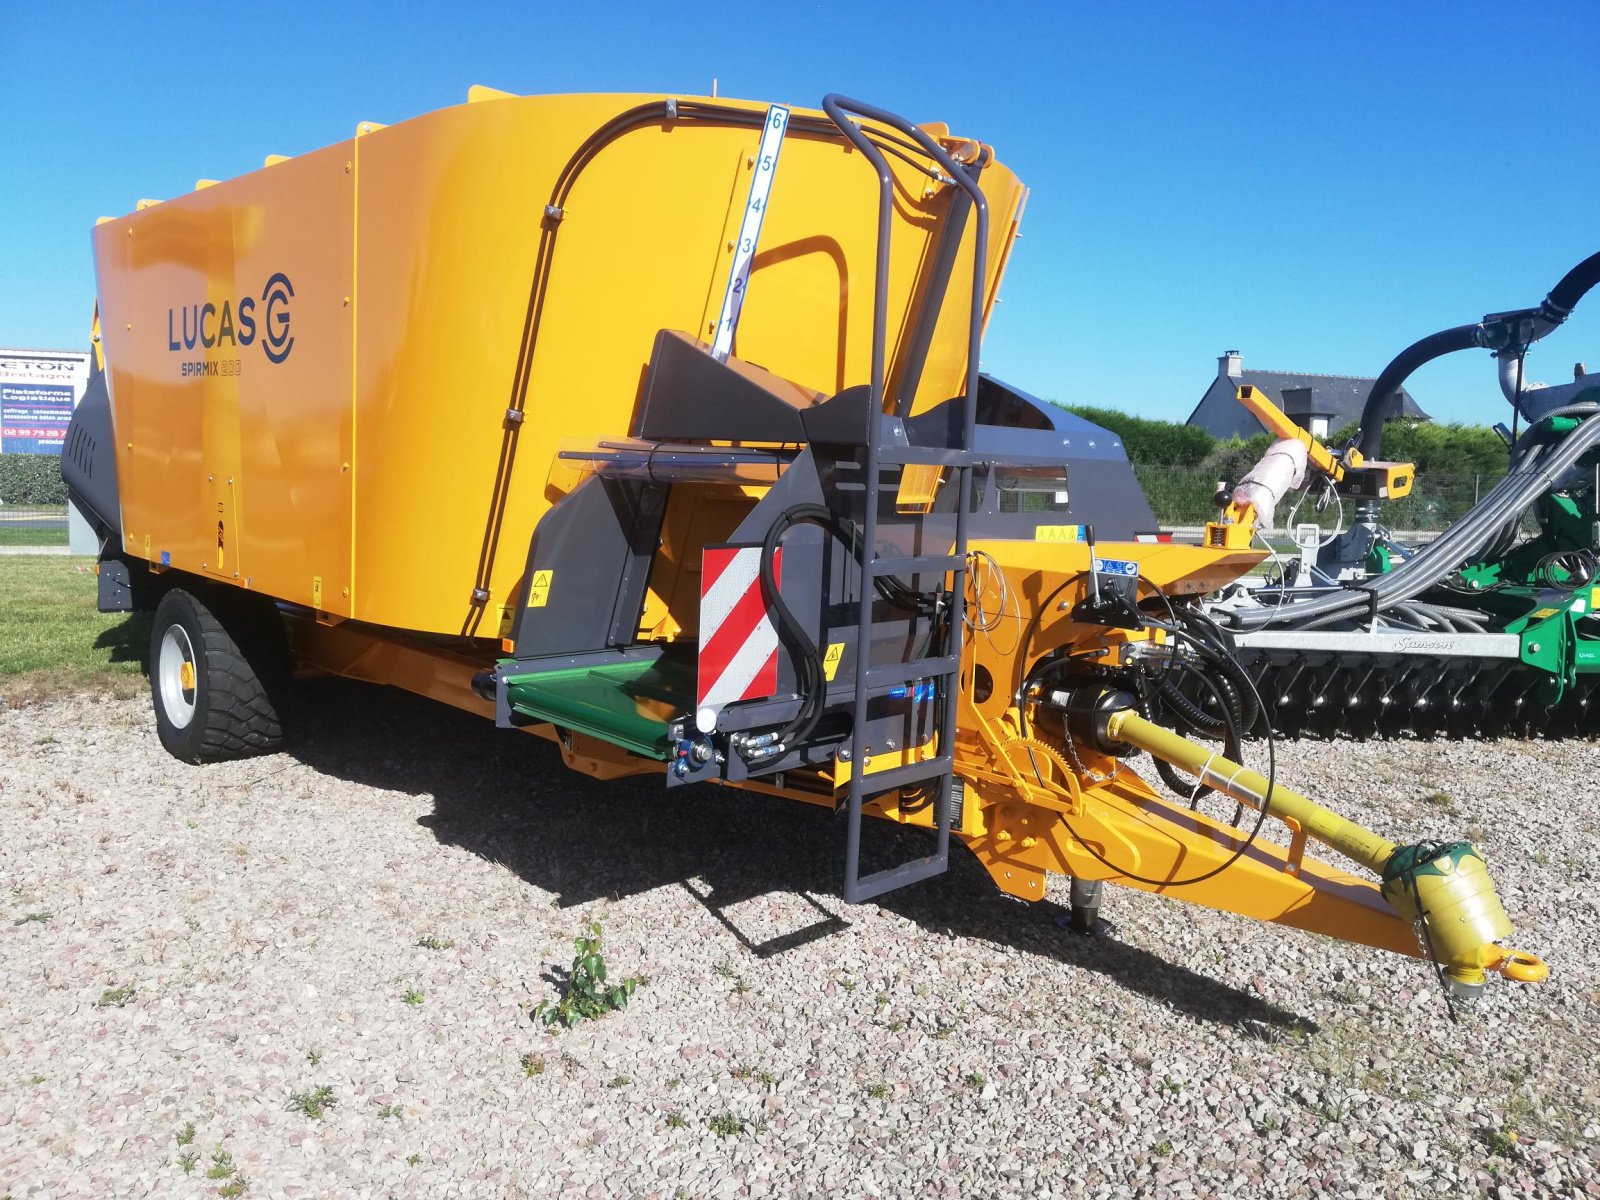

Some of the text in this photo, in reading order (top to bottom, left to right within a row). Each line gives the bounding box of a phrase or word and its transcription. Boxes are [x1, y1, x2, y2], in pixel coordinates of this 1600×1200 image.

[771, 112, 784, 130] 6
[761, 155, 773, 172] 5
[751, 198, 763, 214] 4
[741, 238, 752, 255] 3
[731, 278, 743, 294] 2
[168, 296, 256, 351] LUCAS
[725, 316, 735, 333] 1
[181, 359, 242, 377] SPIRMIX 200
[4, 428, 17, 436] 02
[1394, 636, 1455, 652] Samson
